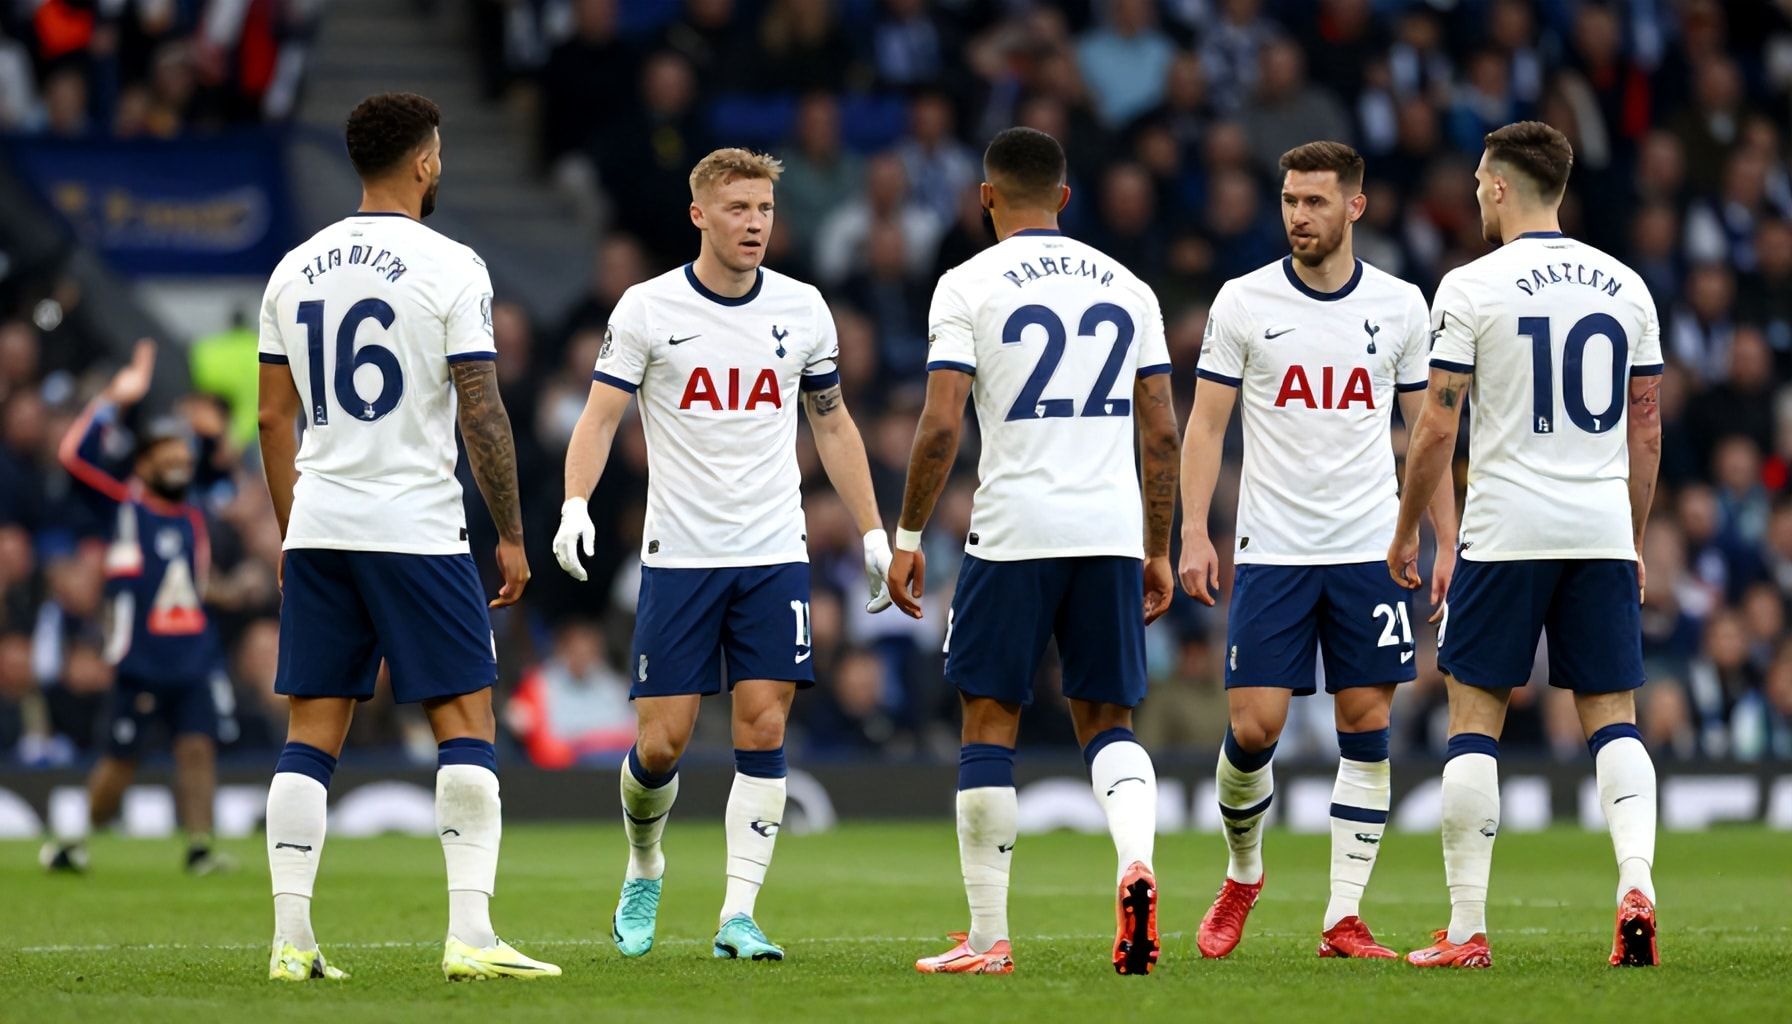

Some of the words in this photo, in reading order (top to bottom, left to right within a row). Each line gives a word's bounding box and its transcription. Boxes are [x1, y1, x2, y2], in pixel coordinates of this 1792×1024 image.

[296, 297, 404, 426] 16
[679, 366, 782, 411] AIA
[1002, 302, 1135, 421] 22
[1274, 364, 1376, 410] AIA
[1517, 312, 1628, 434] 10
[1372, 601, 1413, 648] 21
